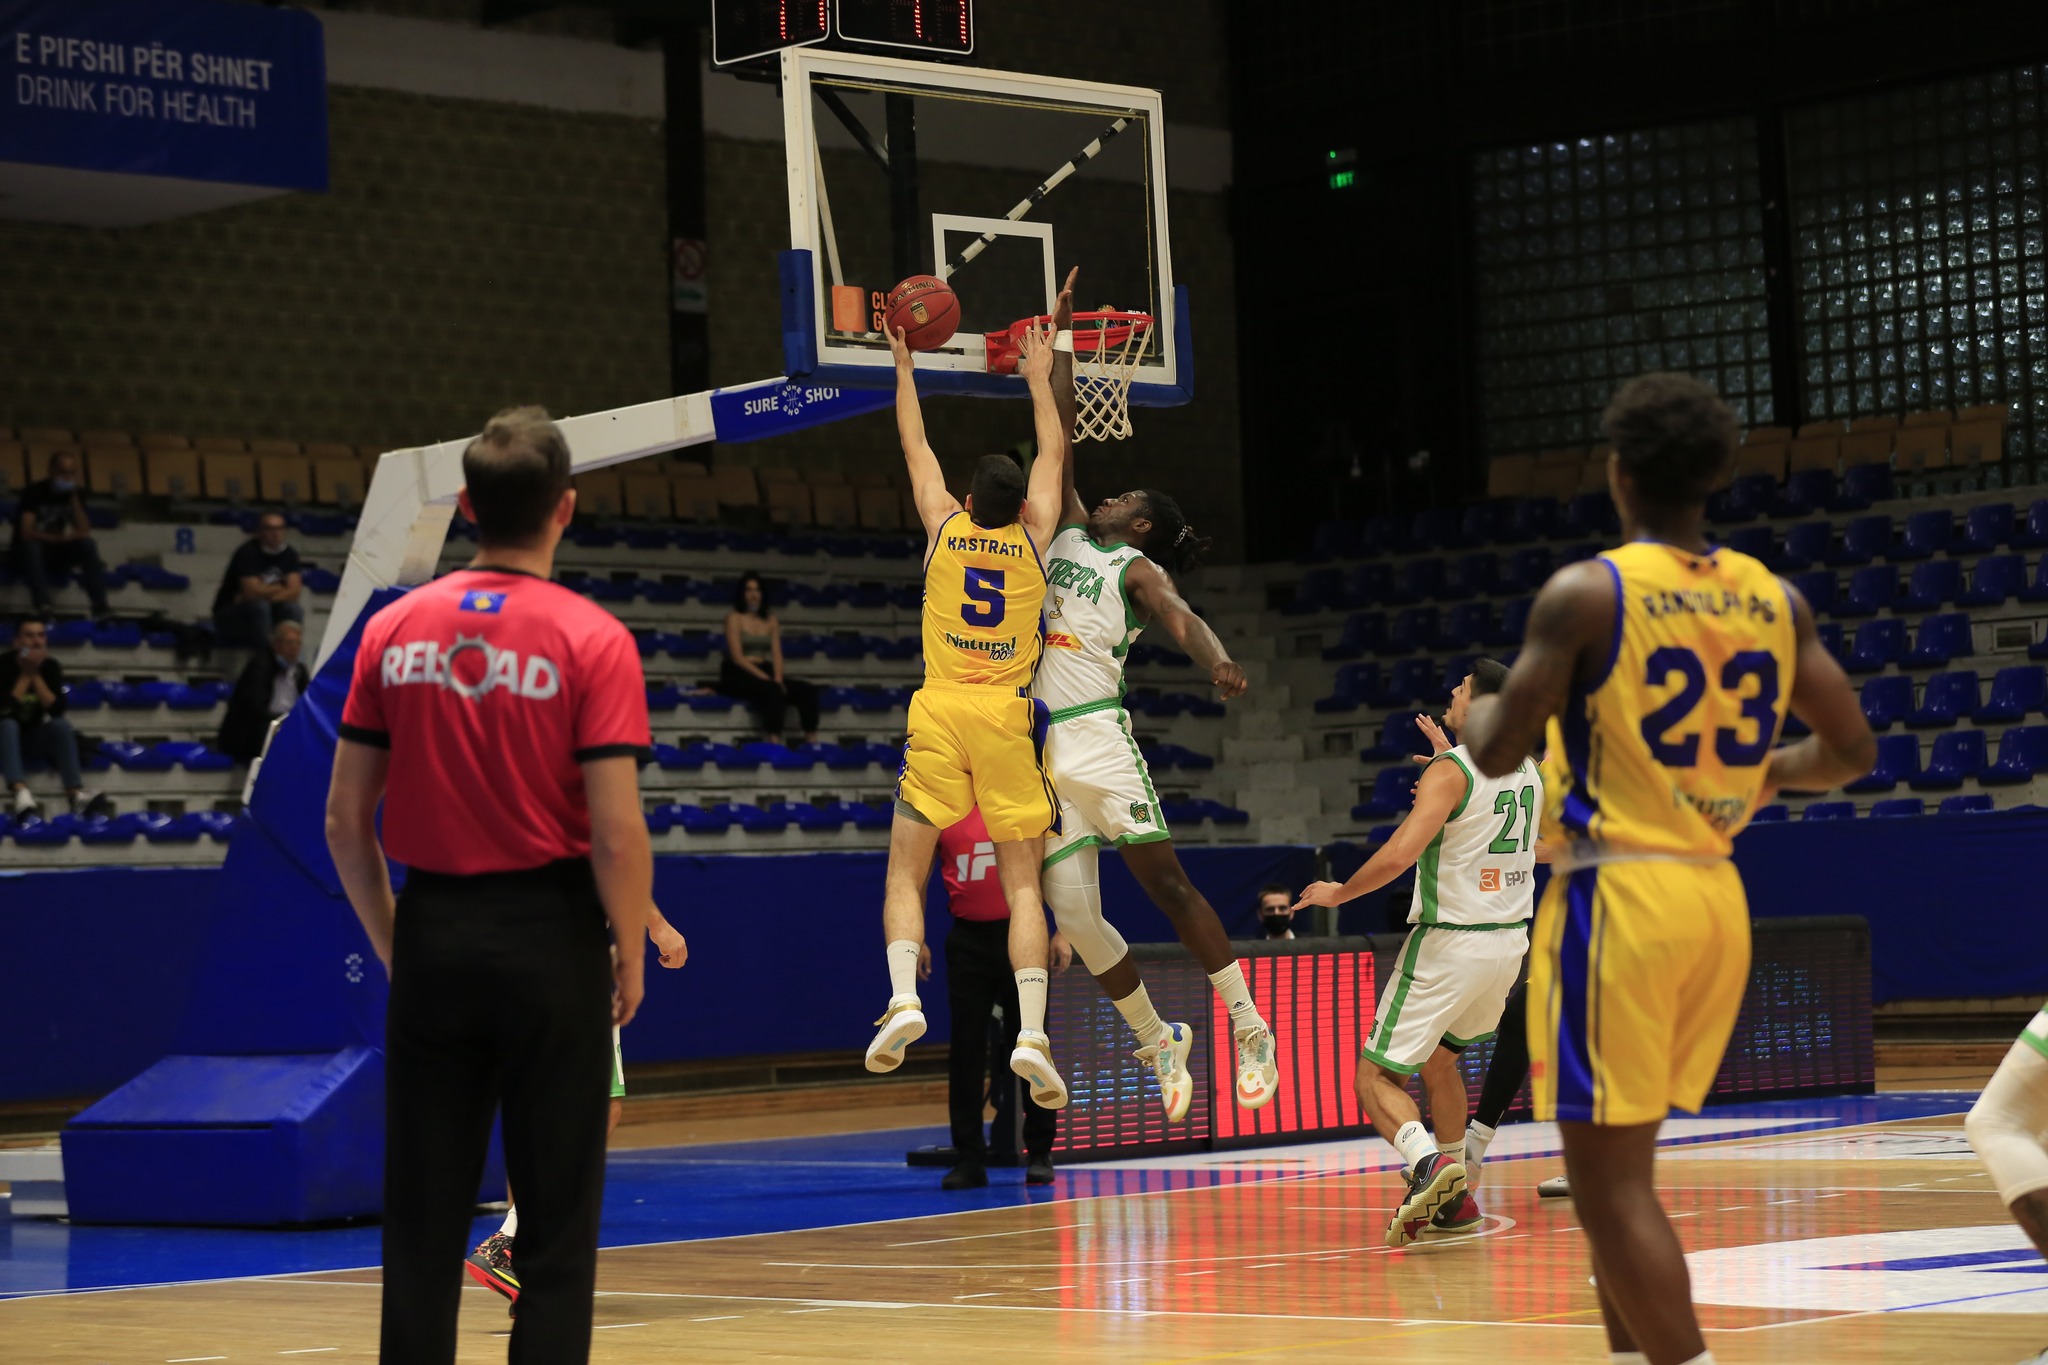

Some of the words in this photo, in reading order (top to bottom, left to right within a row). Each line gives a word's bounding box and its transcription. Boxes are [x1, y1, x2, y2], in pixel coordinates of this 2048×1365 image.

[17, 33, 31, 63] E
[39, 36, 125, 75] PIFSHI
[133, 42, 184, 81] PËR
[191, 53, 272, 91] SHNET
[17, 74, 98, 112] DRINK
[104, 84, 155, 118] FOR
[163, 91, 256, 129] HEALTH
[872, 291, 892, 310] CL
[744, 396, 779, 416] SURE
[948, 536, 1024, 558] KASTRATI
[1047, 558, 1105, 605] TREPÇA
[961, 566, 1005, 628] 5
[1049, 596, 1064, 619] 3
[945, 632, 1017, 651] Natural
[1044, 634, 1071, 648] HL
[988, 649, 1016, 661] 100%
[382, 633, 560, 702] RELOAD
[1641, 646, 1779, 768] 23
[1488, 785, 1535, 854] 21
[1019, 977, 1044, 985] JAKO
